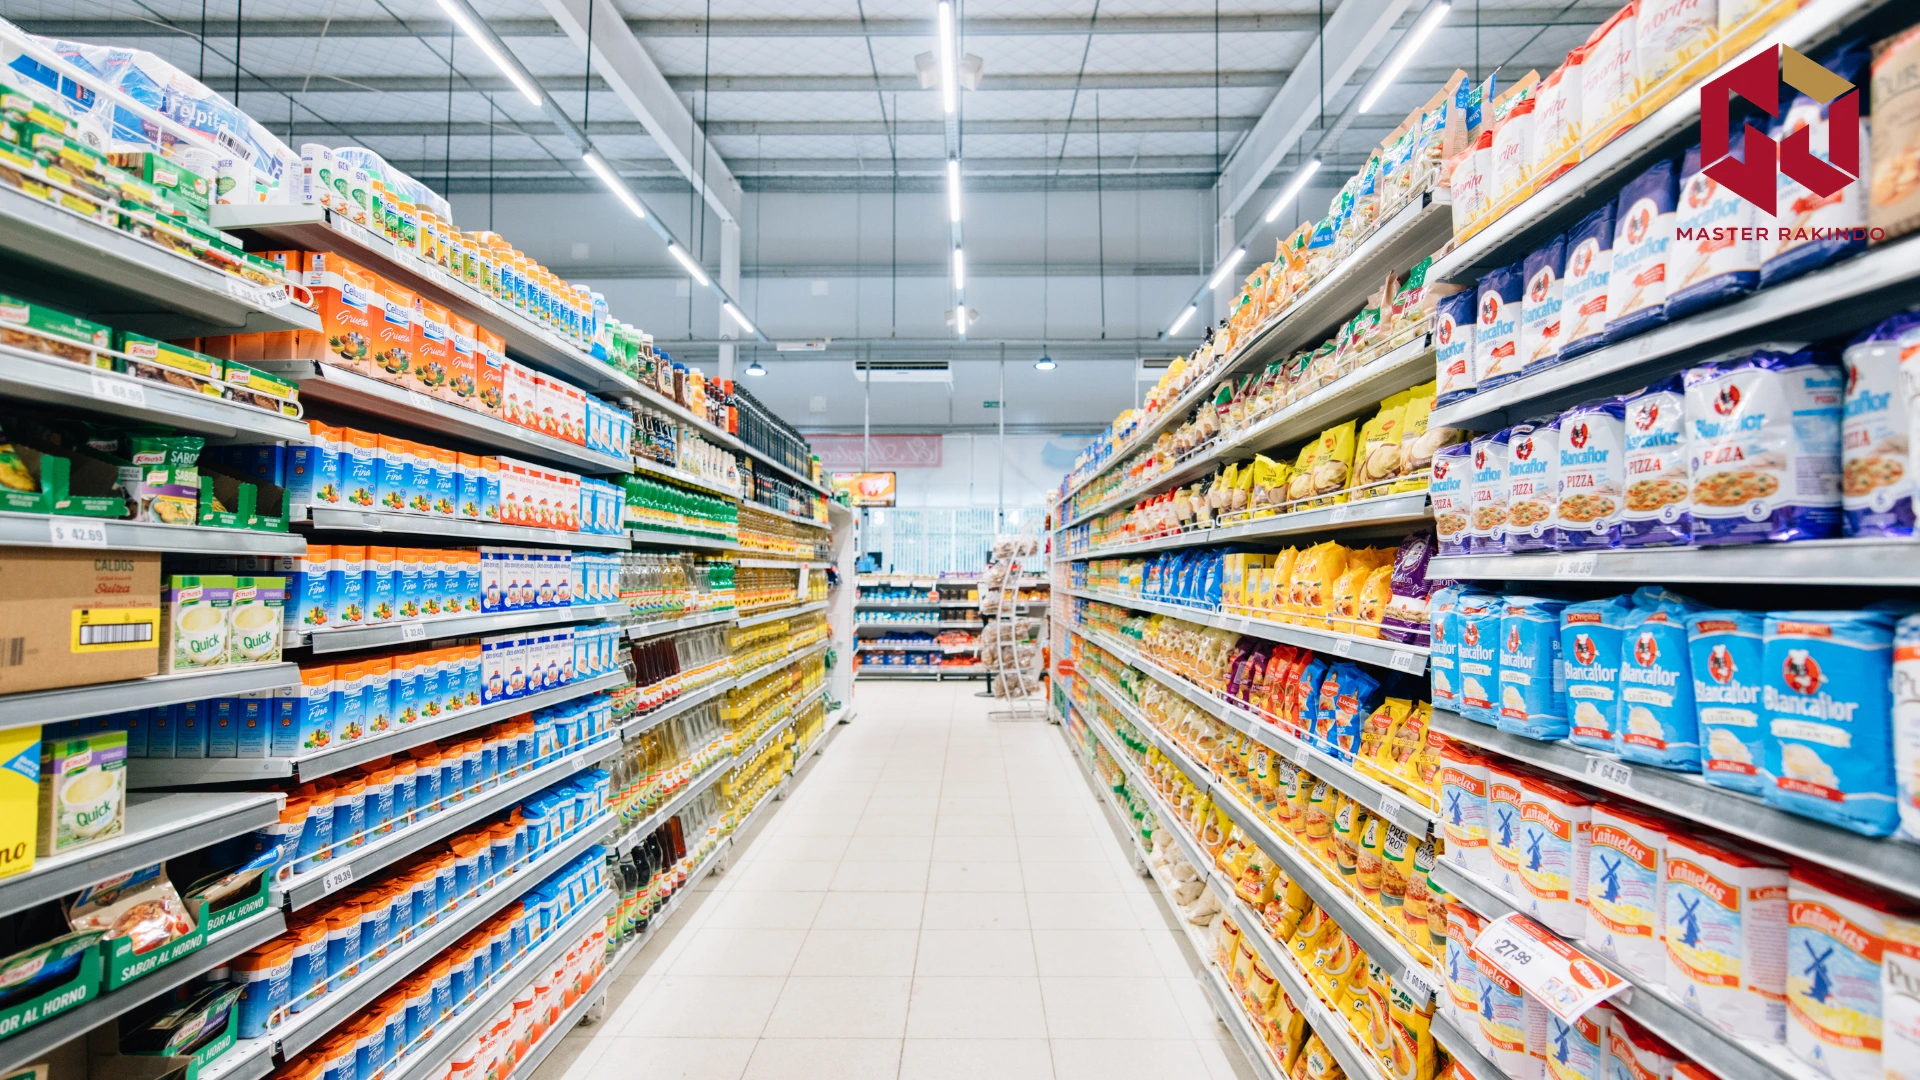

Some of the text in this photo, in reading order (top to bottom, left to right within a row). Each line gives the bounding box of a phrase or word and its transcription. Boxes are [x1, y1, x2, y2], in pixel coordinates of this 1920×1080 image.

[343, 283, 367, 301] Celusal
[336, 309, 368, 327] Gruesa
[386, 302, 409, 319] Celusal
[424, 319, 445, 335] Celusal
[419, 342, 446, 357] Gruesa
[454, 334, 473, 350] Celusal
[230, 373, 249, 381] Knorr
[135, 454, 163, 463] Knorr
[354, 446, 372, 458] Celusal
[1560, 446, 1609, 466] Blancaflor
[414, 456, 429, 467] Celusal
[1509, 459, 1548, 476] Blancaflor
[1629, 457, 1661, 475] PIZZA
[1512, 483, 1533, 496] PIZZA
[1566, 474, 1594, 489] PIZZA
[1434, 499, 1452, 509] PIZZA
[1752, 503, 1762, 515] 6
[1664, 507, 1672, 518] 6
[56, 524, 103, 541] $ 42.69
[1493, 528, 1498, 537] 6
[1533, 526, 1539, 534] 6
[1595, 522, 1603, 530] 6
[1455, 533, 1460, 541] 6
[94, 560, 134, 571] CALDOS
[309, 563, 326, 573] Celusal
[345, 564, 361, 572] Celusal
[1558, 561, 1592, 574] $ 90.39
[95, 583, 131, 593] Suiza
[180, 588, 201, 600] Knorr
[234, 588, 256, 599] Knorr
[190, 631, 220, 654] Quick
[243, 631, 271, 650] Quick
[1458, 642, 1495, 661] Blancaflor
[1500, 649, 1535, 669] Blancaflor
[1565, 662, 1618, 682] Blancaflor
[1622, 662, 1680, 686] Blancaflor
[309, 685, 329, 697] Celusal
[345, 680, 362, 692] Celusal
[1696, 680, 1761, 704] Blancaflor
[1574, 690, 1605, 699] LEUDANTE
[1629, 694, 1663, 704] LEUDANTE
[1763, 685, 1859, 721] Blancaflor
[65, 756, 90, 770] Knorr
[1441, 769, 1476, 792] Cañuelas
[1590, 762, 1628, 784] $ 64.99
[76, 800, 111, 827] Quick
[1380, 801, 1399, 818] $ 122.99
[1521, 804, 1561, 833] Cañuelas
[1389, 825, 1408, 840] PRES
[1468, 839, 1479, 847] 000
[1592, 827, 1646, 862] Cañuelas
[326, 869, 351, 888] $ 29.39
[1668, 861, 1726, 901] Cañuelas
[1546, 891, 1557, 899] 000
[207, 896, 264, 931] BOR AL HORNO
[1625, 926, 1639, 934] 000
[1792, 902, 1869, 951] Cañuelas
[1447, 923, 1472, 955] Cañuelas
[121, 933, 202, 982] SABOR AL HORNO
[309, 958, 326, 974] Fina
[1477, 956, 1512, 989] ñuelas
[1406, 970, 1410, 980] $
[268, 983, 290, 1000] Fina
[22, 985, 86, 1026] AL HORNO
[206, 1035, 231, 1060] HORNO
[1401, 1027, 1417, 1053] Polenta
